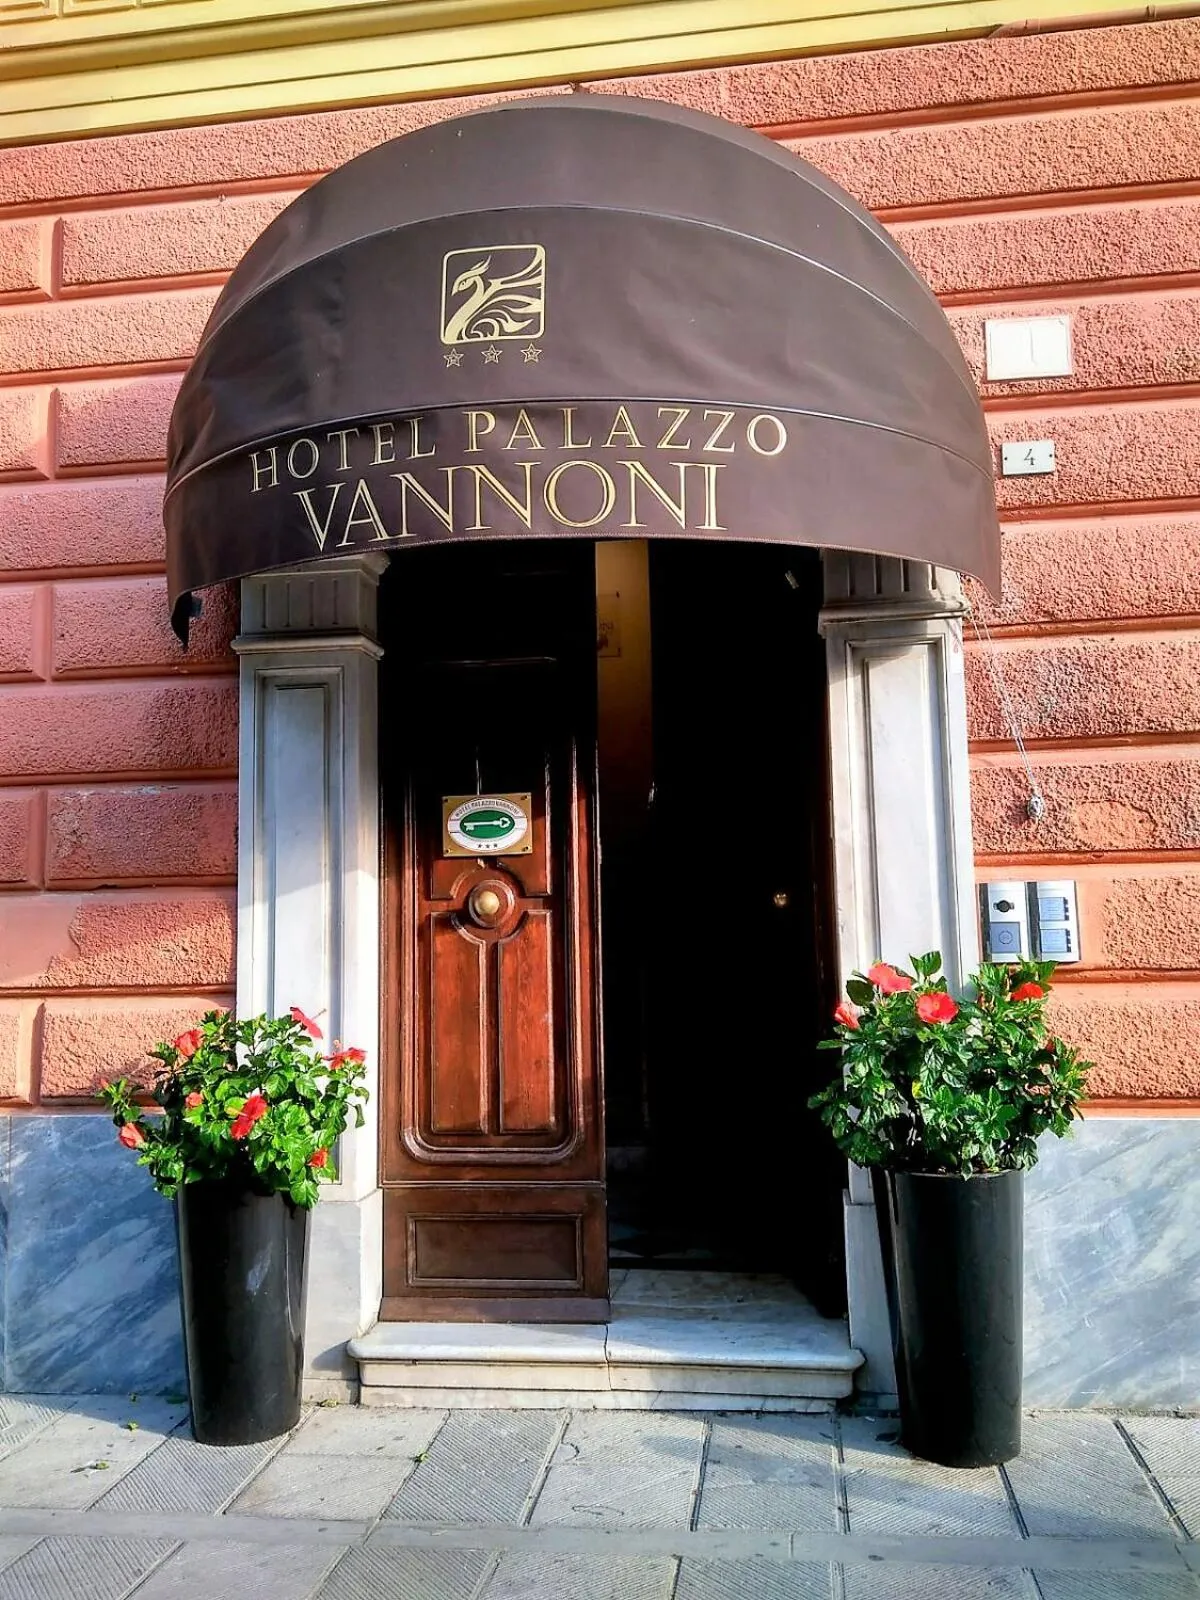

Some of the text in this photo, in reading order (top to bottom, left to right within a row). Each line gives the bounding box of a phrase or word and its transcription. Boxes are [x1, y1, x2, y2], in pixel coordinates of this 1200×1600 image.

[249, 406, 787, 493] HOTEL PALAZZO
[1023, 448, 1036, 466] 4
[293, 460, 728, 552] VANNONI
